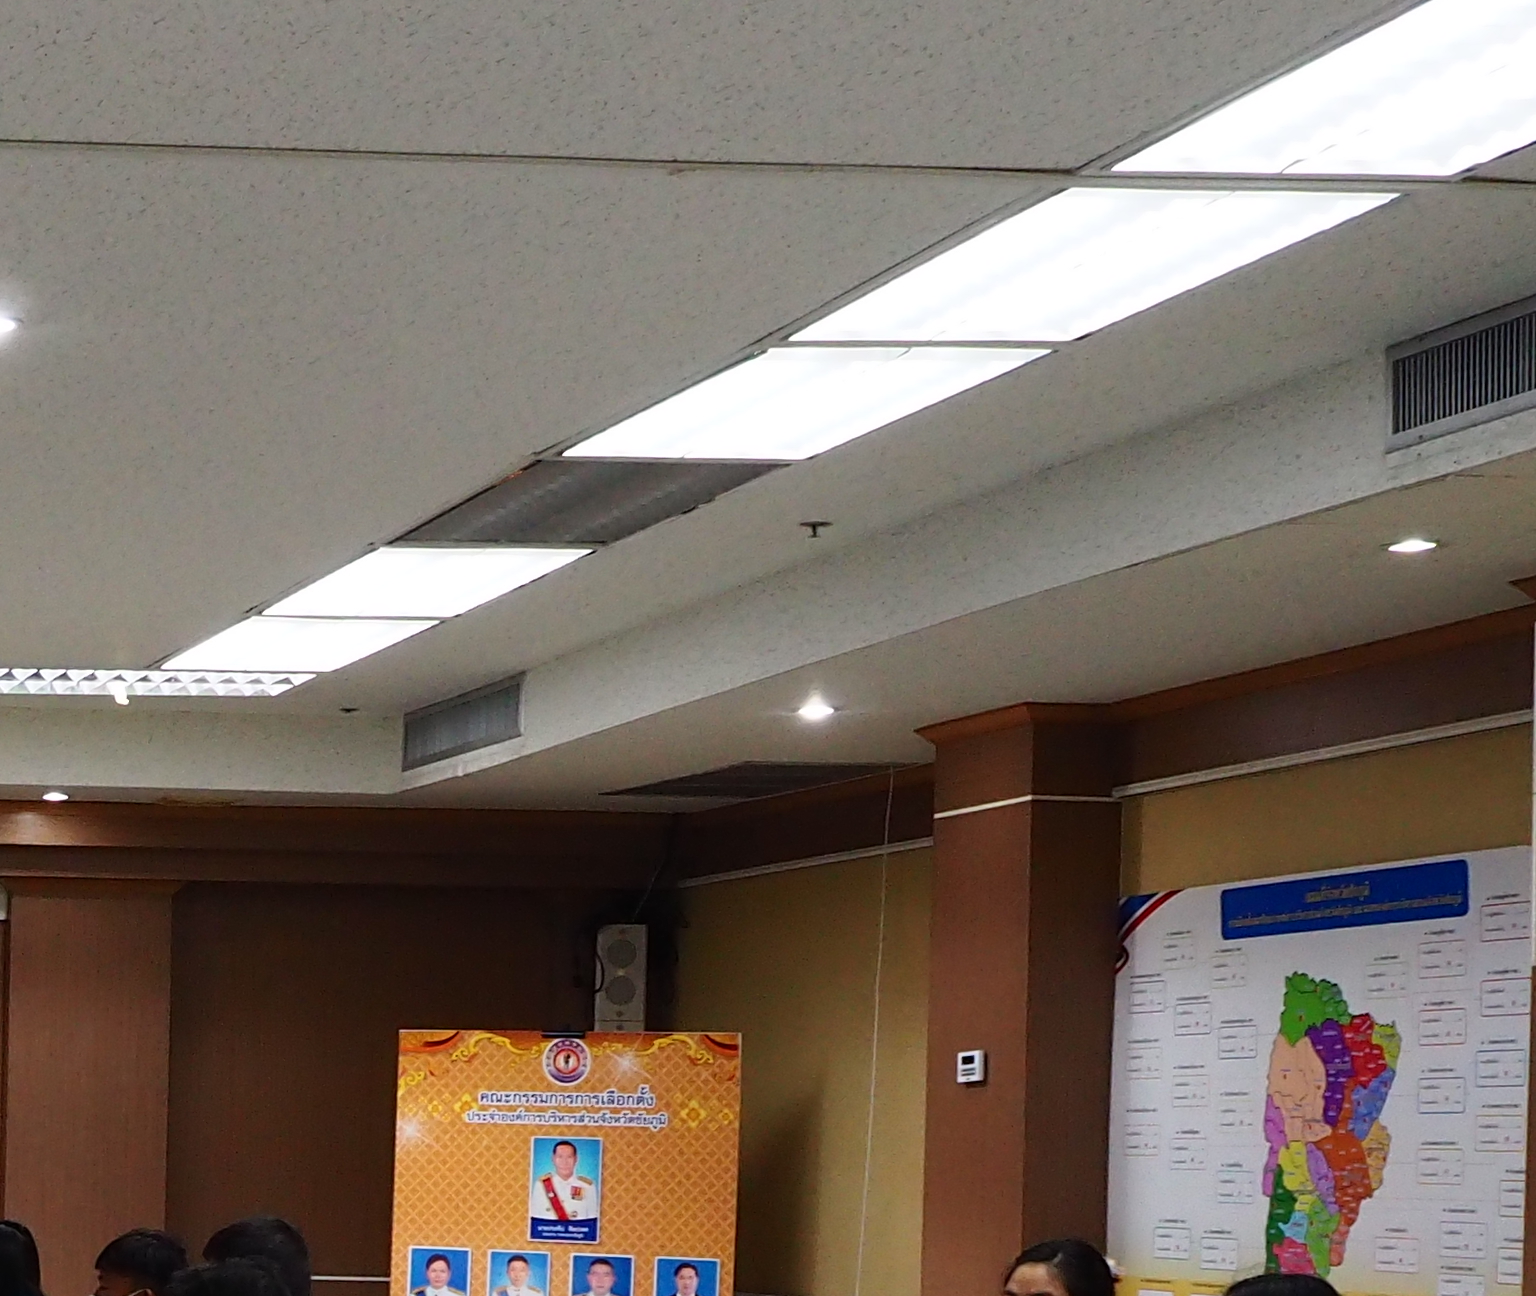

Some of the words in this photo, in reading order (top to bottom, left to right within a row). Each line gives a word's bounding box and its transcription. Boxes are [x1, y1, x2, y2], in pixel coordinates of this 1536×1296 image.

[479, 1086, 655, 1107] คณะกรรมการการเลือกตั้ง
